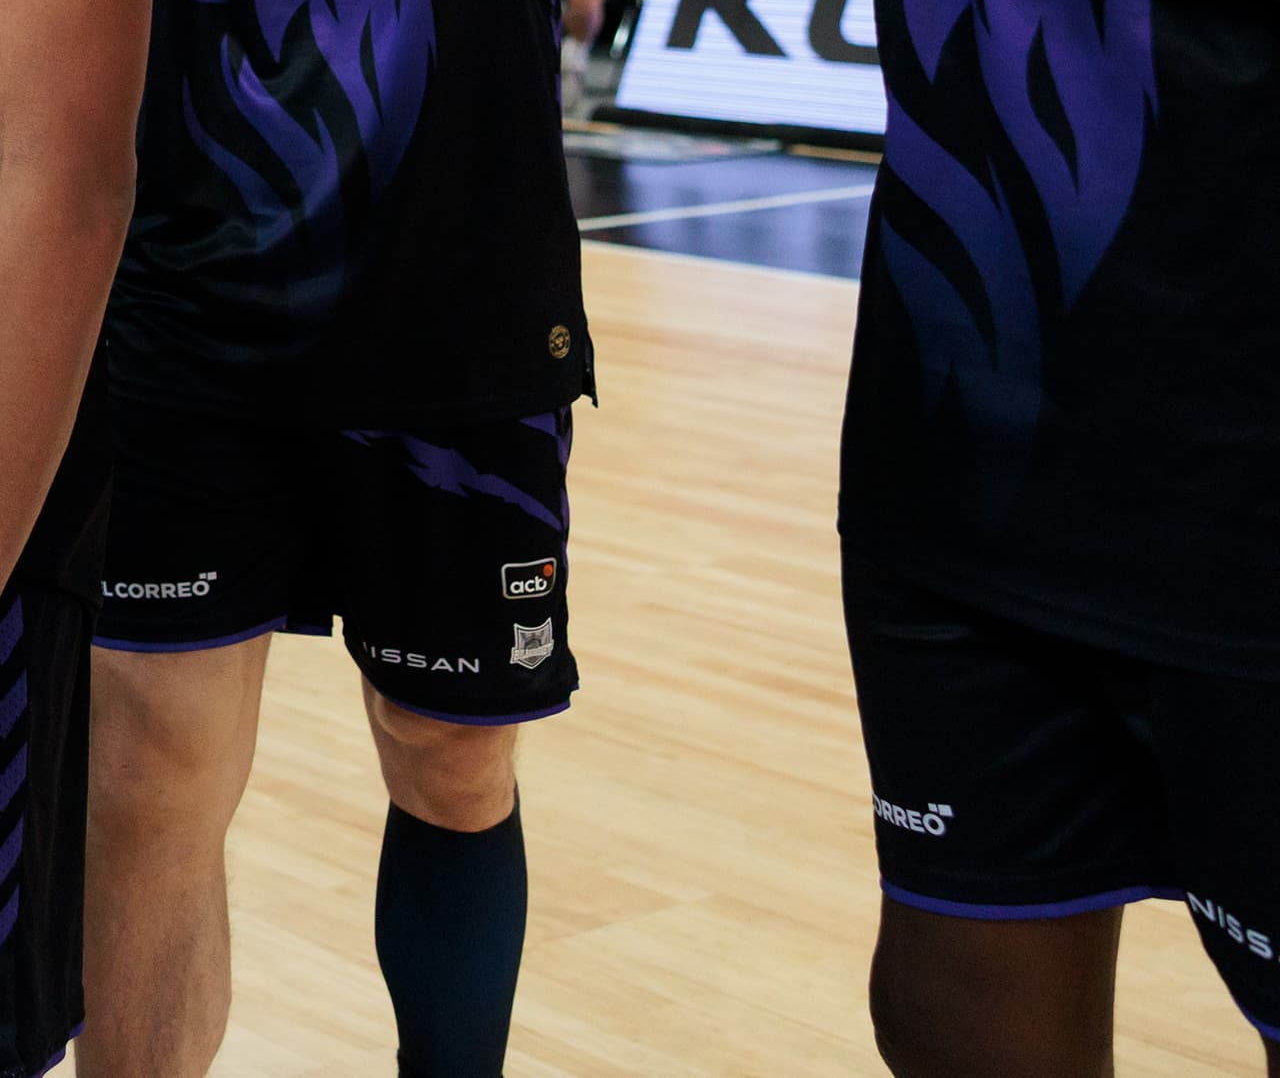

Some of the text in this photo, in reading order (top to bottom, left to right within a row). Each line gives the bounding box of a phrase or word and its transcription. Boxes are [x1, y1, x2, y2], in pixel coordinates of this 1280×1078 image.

[114, 580, 210, 599] CORREO
[510, 576, 547, 594] acb
[363, 641, 480, 673] ISSAN
